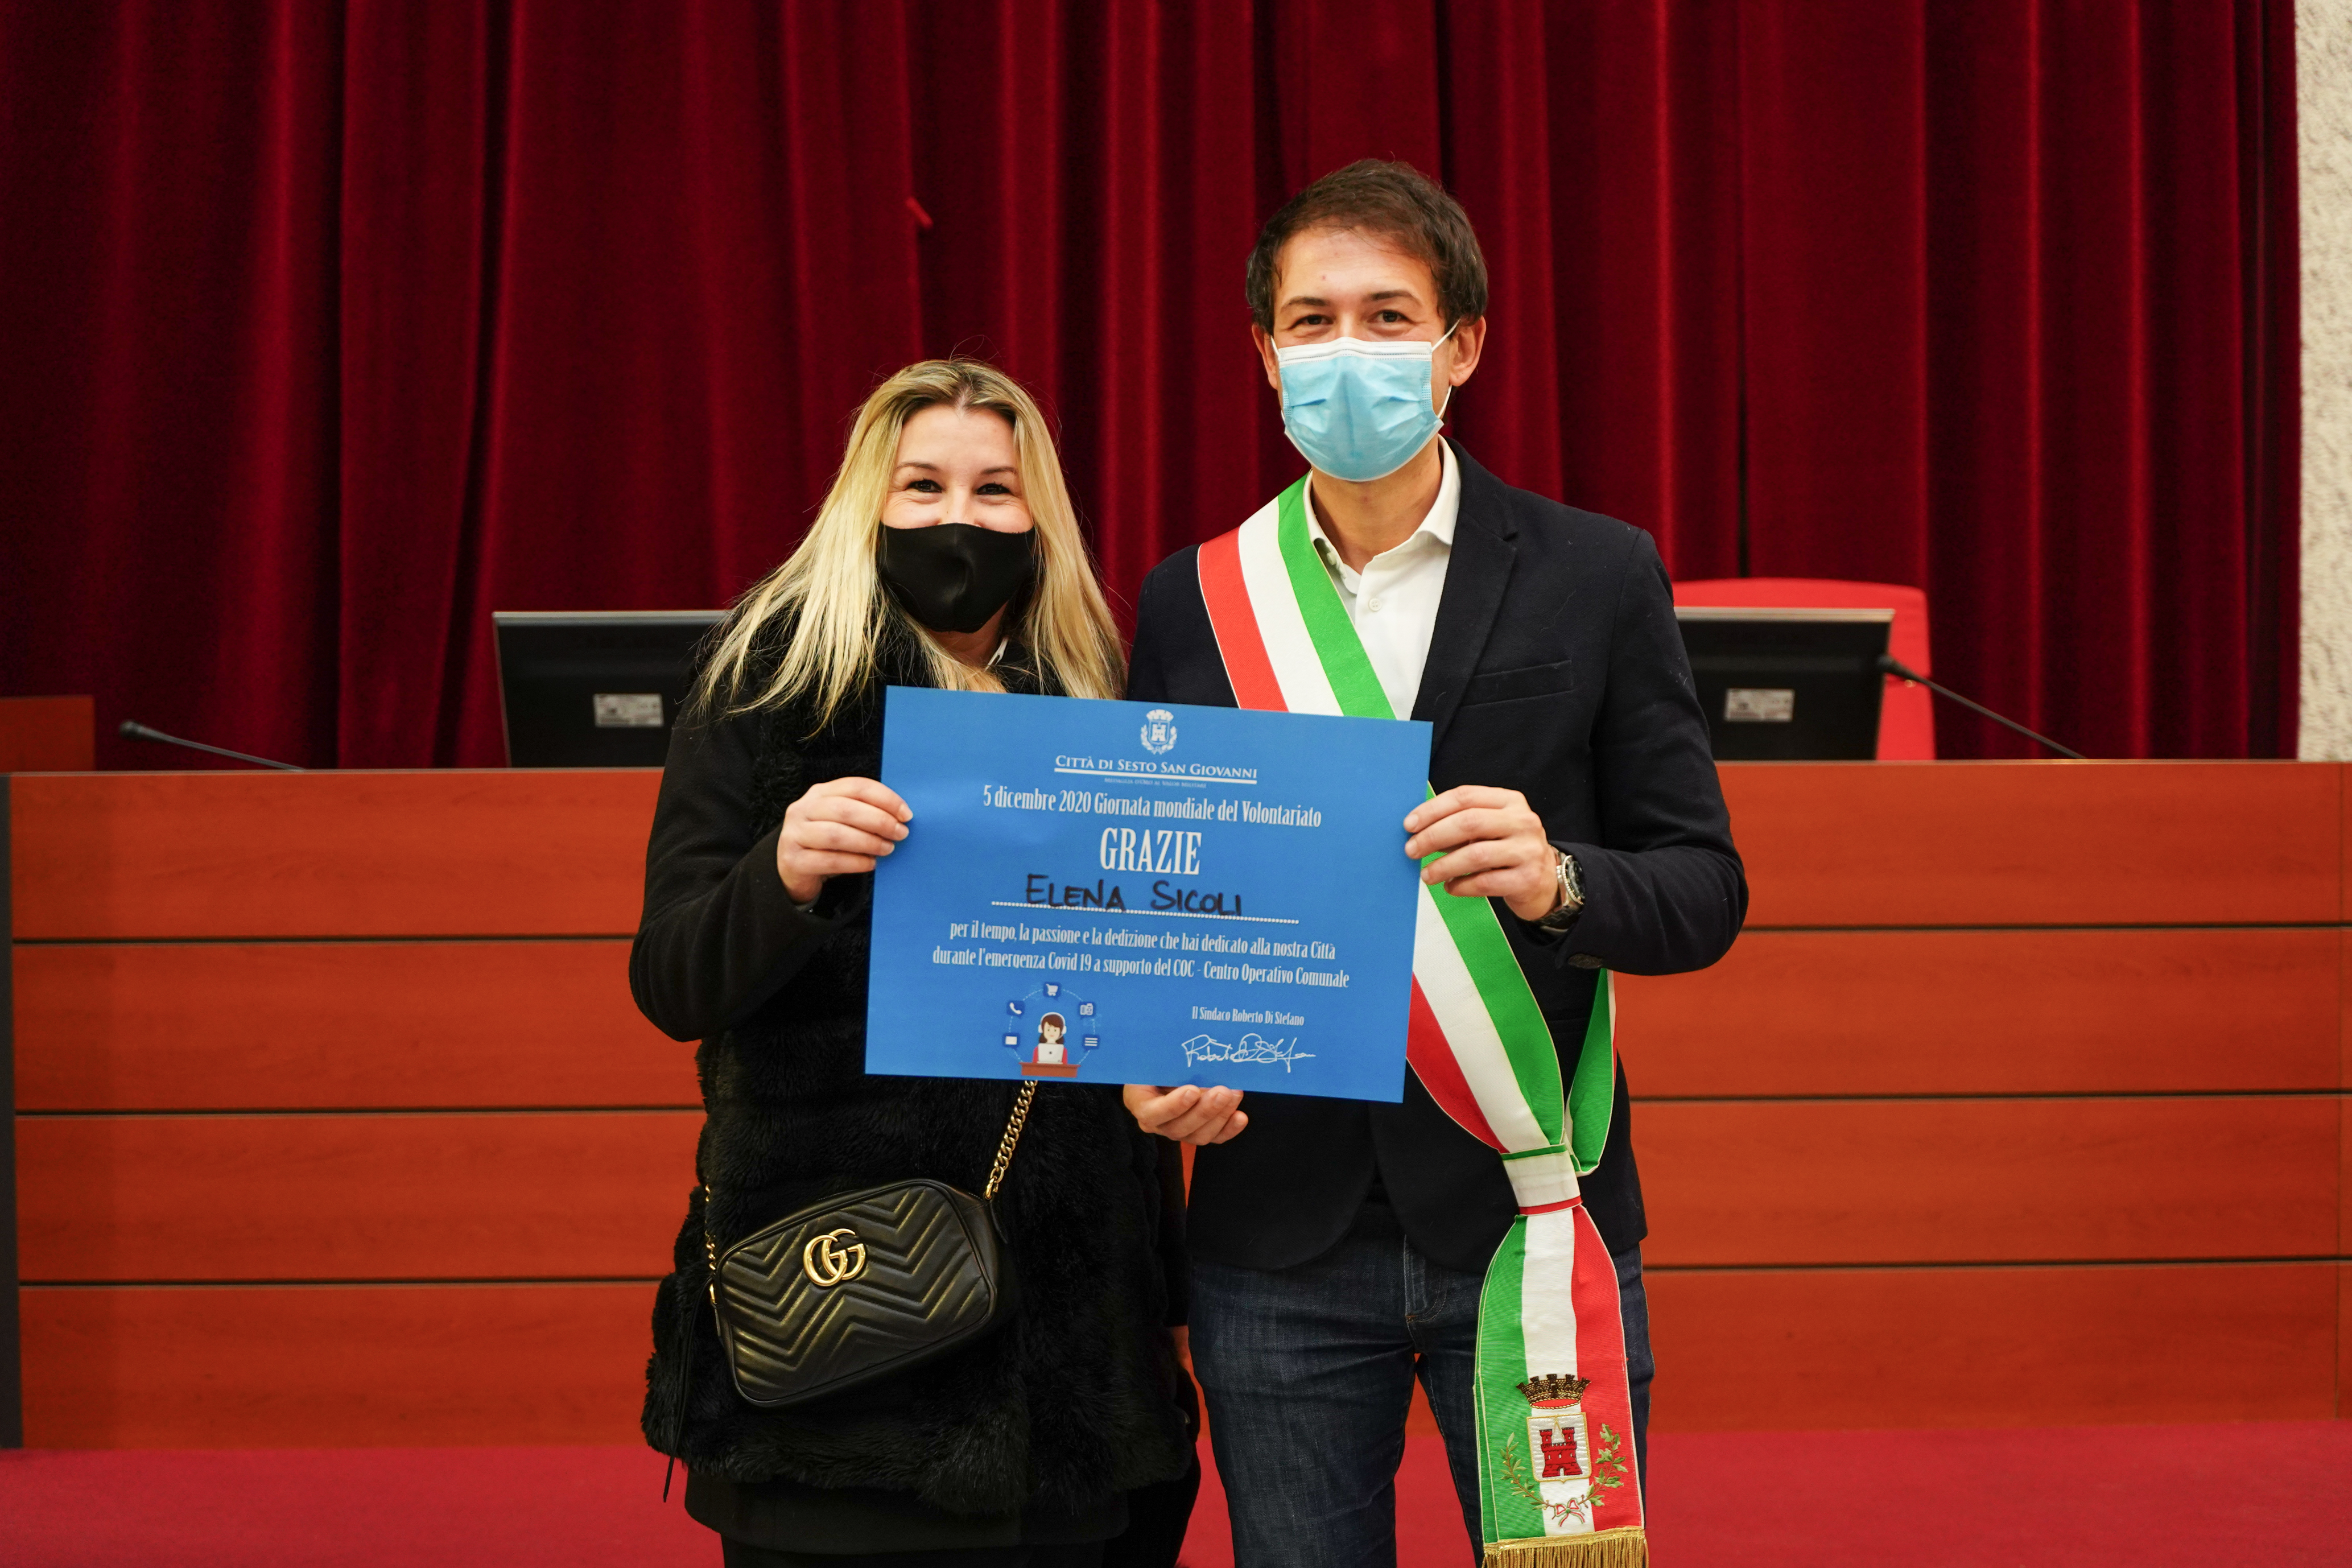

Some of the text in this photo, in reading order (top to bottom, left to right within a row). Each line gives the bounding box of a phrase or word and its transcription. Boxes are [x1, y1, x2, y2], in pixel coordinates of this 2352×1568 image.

[984, 785, 1321, 827] 5 dicembre 2020 Giornata mondiale del Volontariato
[1100, 828, 1202, 874] GRAZIE
[1025, 873, 1242, 916] ELENA SICOLI
[950, 921, 1335, 959] per il tempo, la passione e la dedizione che hai dedicato alla nostra Città
[933, 946, 976, 964] durante
[979, 948, 1045, 968] l'emergenza
[1049, 952, 1077, 970] Covid
[1080, 954, 1091, 971] 19
[1094, 959, 1100, 971] a
[1103, 959, 1152, 976] supporto
[1154, 958, 1171, 976] del
[1174, 959, 1195, 977] COC
[1204, 962, 1239, 980] Centro
[1242, 964, 1293, 984] Operativo
[1296, 967, 1349, 987] Comunale
[1200, 1007, 1230, 1021] Sindaco
[1232, 1009, 1263, 1023] Roberto
[1265, 1011, 1273, 1024] Di
[1275, 1012, 1304, 1025] Stefano
